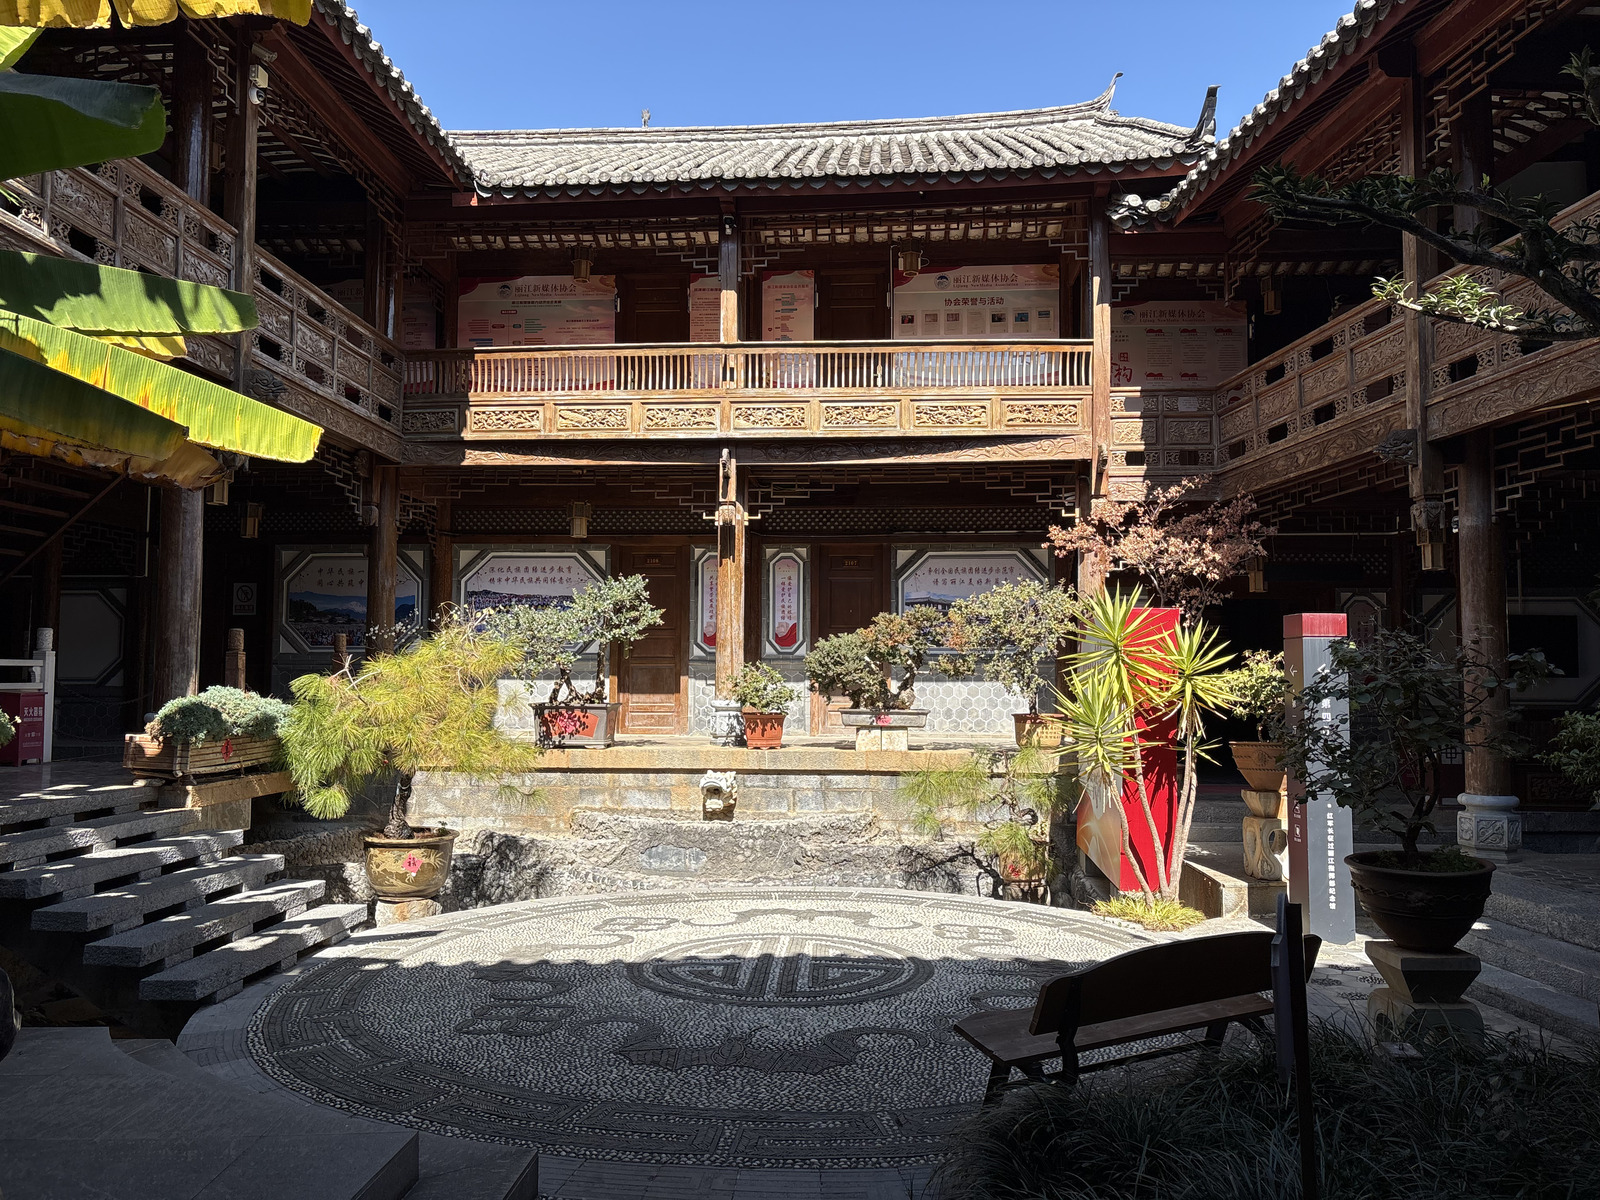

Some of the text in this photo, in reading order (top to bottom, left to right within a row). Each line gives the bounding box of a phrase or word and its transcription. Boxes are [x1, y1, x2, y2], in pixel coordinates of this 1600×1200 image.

[953, 273, 1019, 284] 丽江新媒体协会
[514, 283, 577, 293] 丽江新媒体协会
[944, 296, 1005, 307] 协会荣誉与活动
[1139, 309, 1206, 318] 丽江新媒体协会
[317, 567, 365, 576] 中华民族一
[488, 565, 573, 574] 深化民族团结进步教育
[316, 579, 365, 588] 同心共筑中
[488, 576, 573, 585] 铸牢中华民族共同体意识
